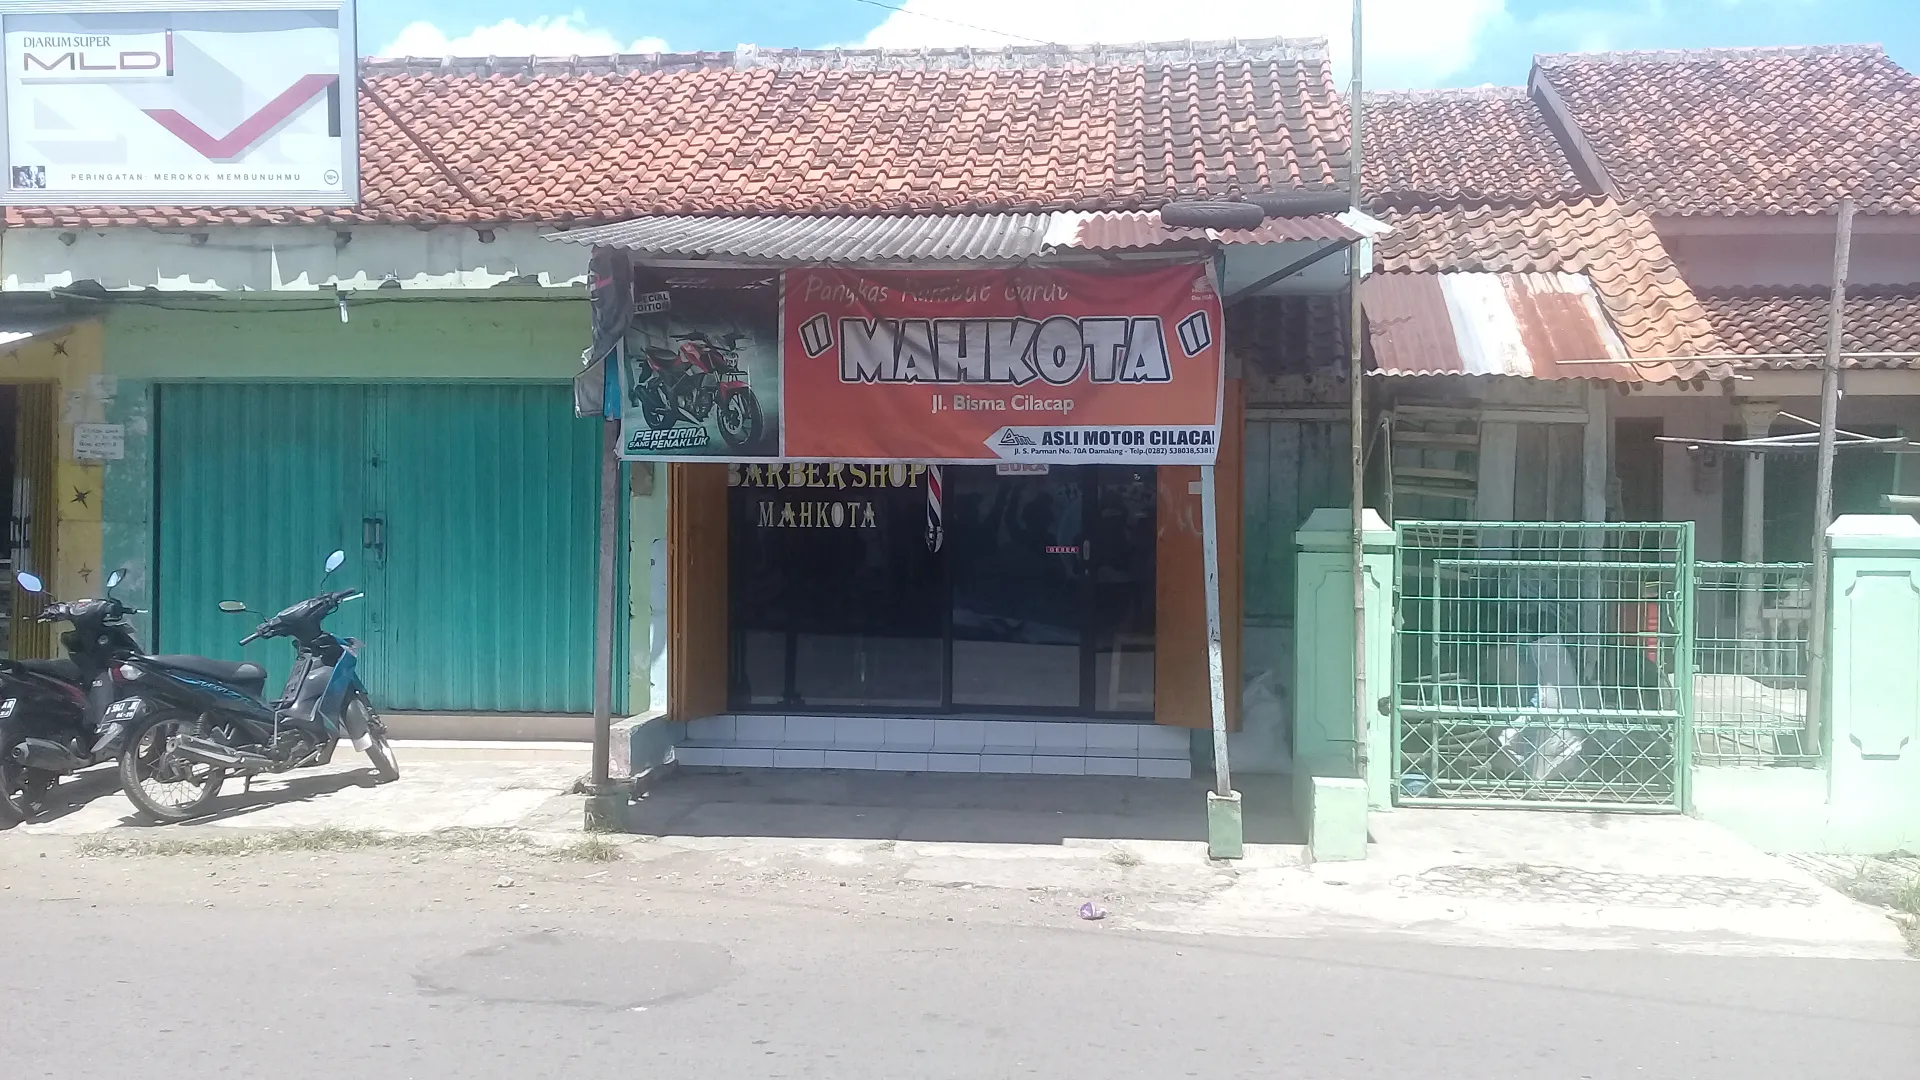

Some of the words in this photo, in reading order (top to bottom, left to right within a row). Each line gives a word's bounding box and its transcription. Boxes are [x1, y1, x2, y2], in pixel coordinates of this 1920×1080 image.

[24, 36, 71, 48] DJARUM
[74, 36, 111, 47] SUPER
[24, 51, 161, 71] MLD
[71, 173, 148, 181] PERINGATAN:
[154, 173, 210, 181] MEROKOK
[217, 173, 301, 181] MEMBUNUHMU
[931, 394, 947, 413] Jl.
[953, 394, 1006, 411] Bisma
[1011, 394, 1074, 415] Cilacap
[634, 428, 705, 441] PERFORMA
[1041, 430, 1079, 446] ASLI
[1083, 430, 1145, 446] MOTOR
[1149, 430, 1214, 446] CILACA
[650, 437, 709, 448] PENAKLUK
[757, 501, 876, 528] MAHKOTA
